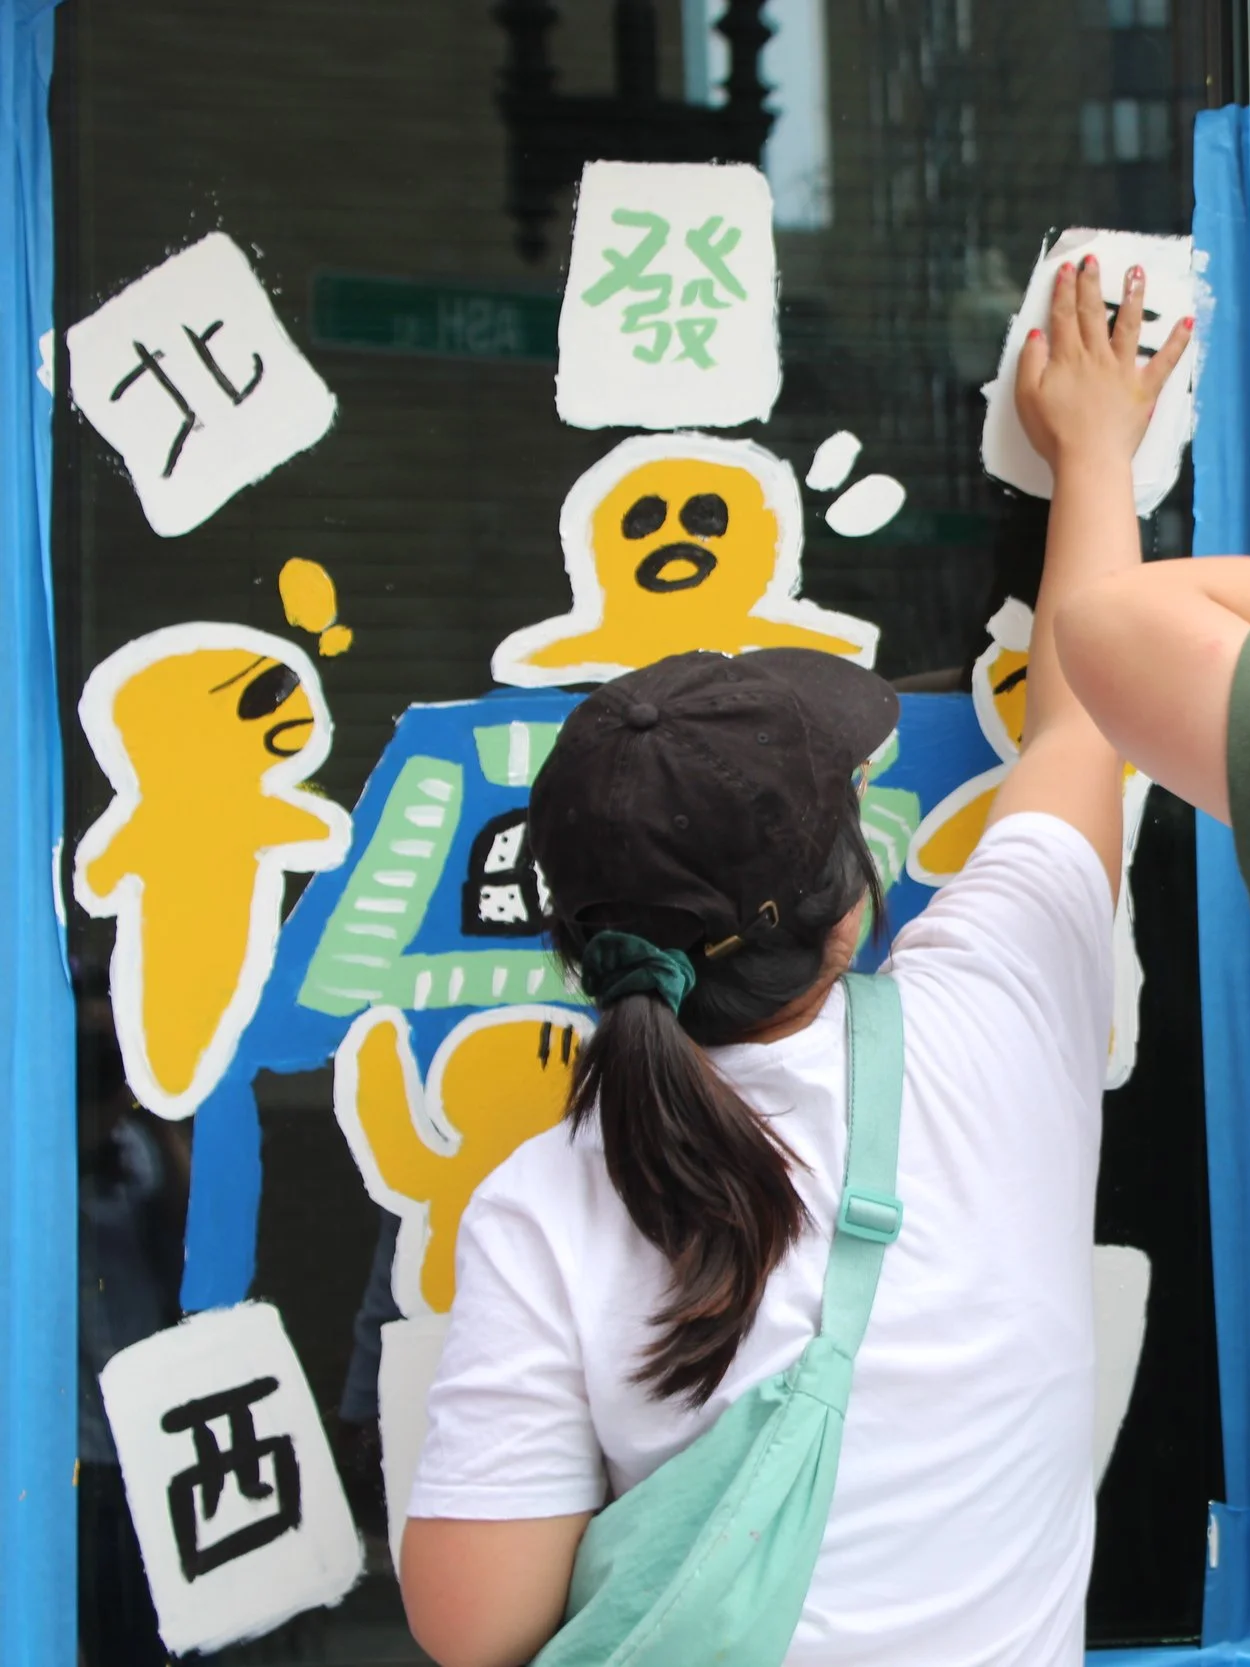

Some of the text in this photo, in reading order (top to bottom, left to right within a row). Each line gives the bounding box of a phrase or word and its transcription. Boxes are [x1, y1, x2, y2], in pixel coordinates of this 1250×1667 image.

[580, 207, 748, 372] 發
[109, 318, 265, 478] 北
[160, 1375, 302, 1584] 西
